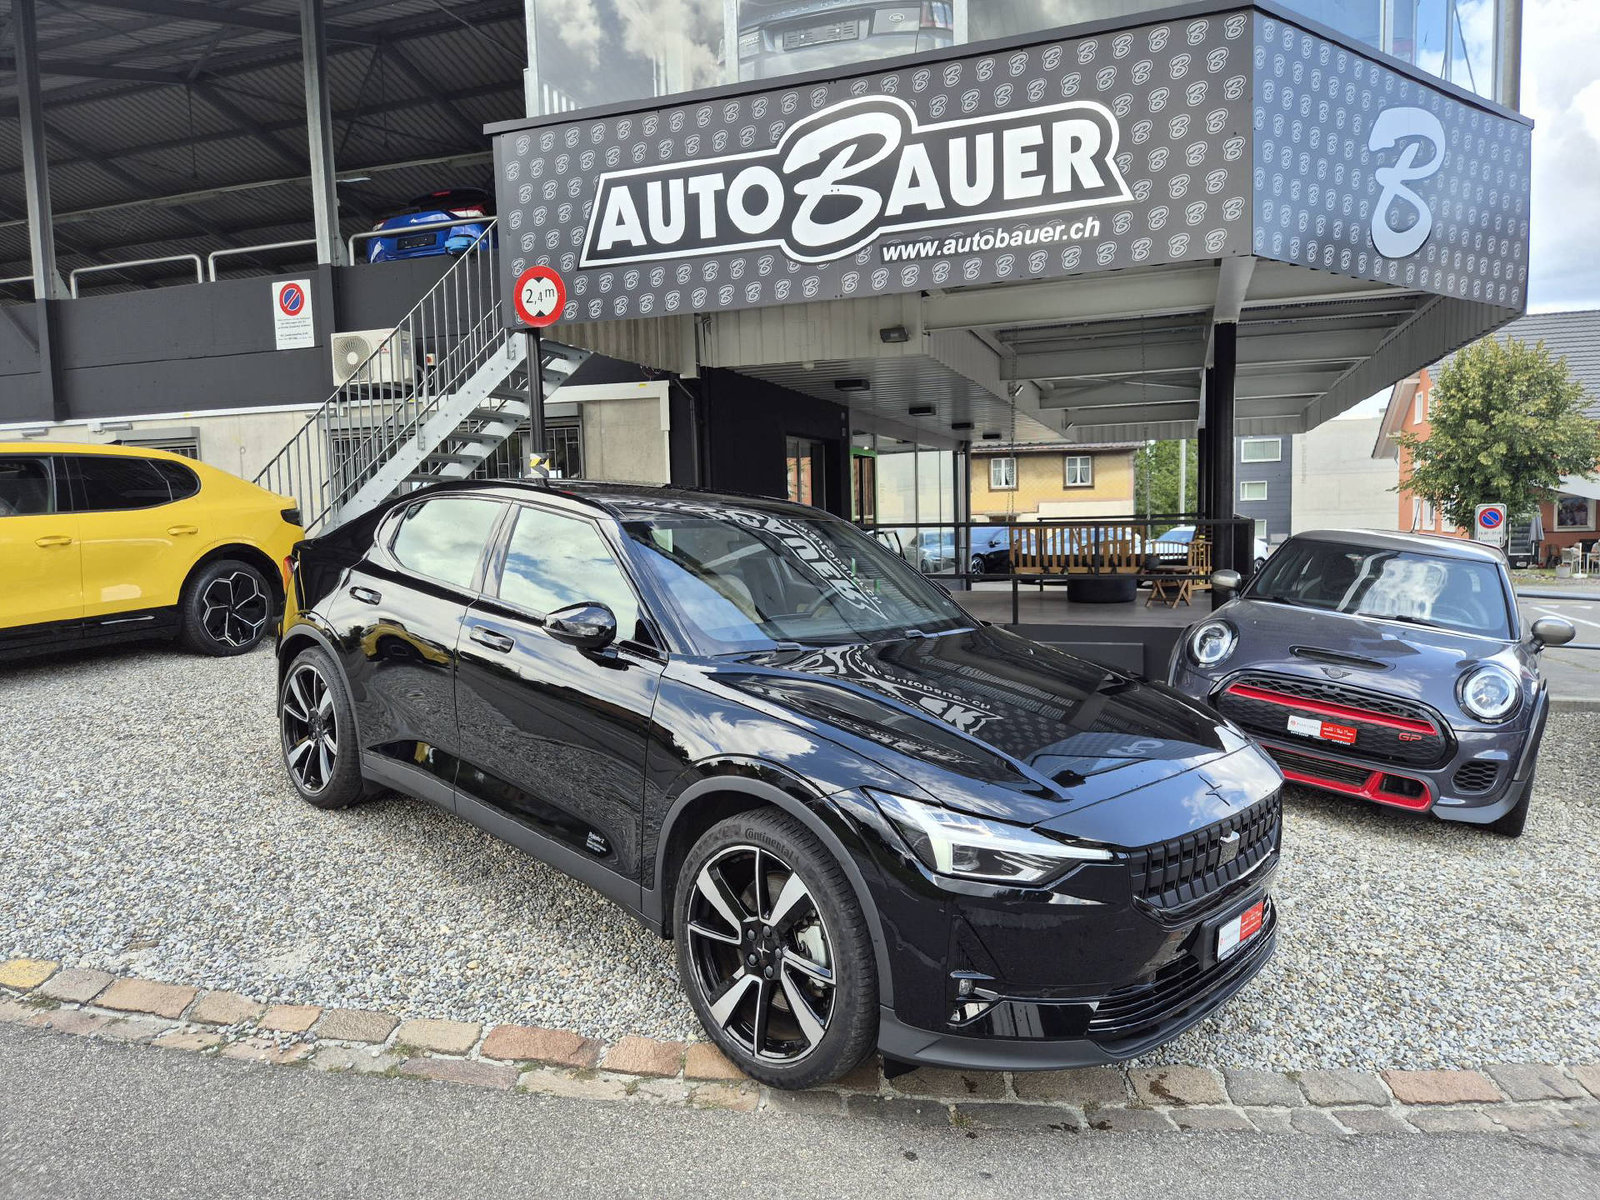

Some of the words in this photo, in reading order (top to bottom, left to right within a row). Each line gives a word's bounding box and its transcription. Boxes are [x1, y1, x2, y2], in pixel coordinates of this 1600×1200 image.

[597, 166, 785, 251] AUTO
[782, 112, 1106, 247] BAUER
[882, 216, 1100, 262] www.autobauer.ch
[1398, 732, 1422, 741] GP
[745, 827, 794, 860] Continental
